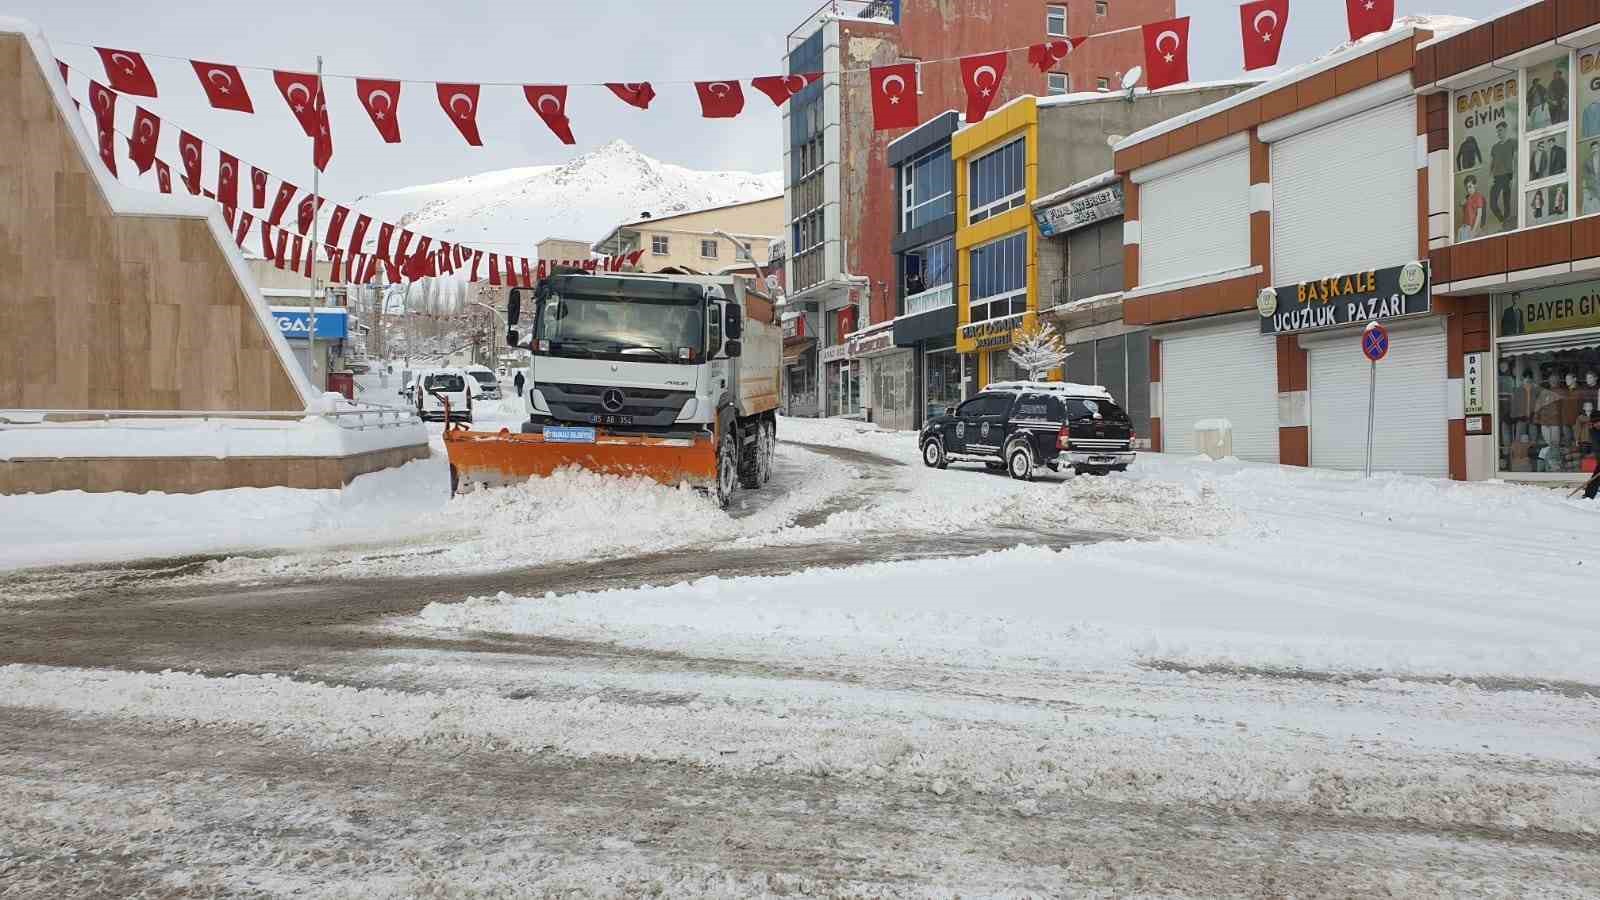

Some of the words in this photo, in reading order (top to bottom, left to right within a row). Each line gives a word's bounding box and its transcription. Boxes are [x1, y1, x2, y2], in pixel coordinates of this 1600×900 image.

[1457, 79, 1517, 113] BAYER
[1464, 106, 1505, 129] GİYİM
[1297, 270, 1377, 304] BAŞKALE
[273, 316, 319, 332] GAZ
[1273, 304, 1336, 332] UCUZLUK
[1347, 294, 1406, 322] PAZARI
[1527, 298, 1574, 322] BAYER
[1469, 356, 1477, 406] BAYER
